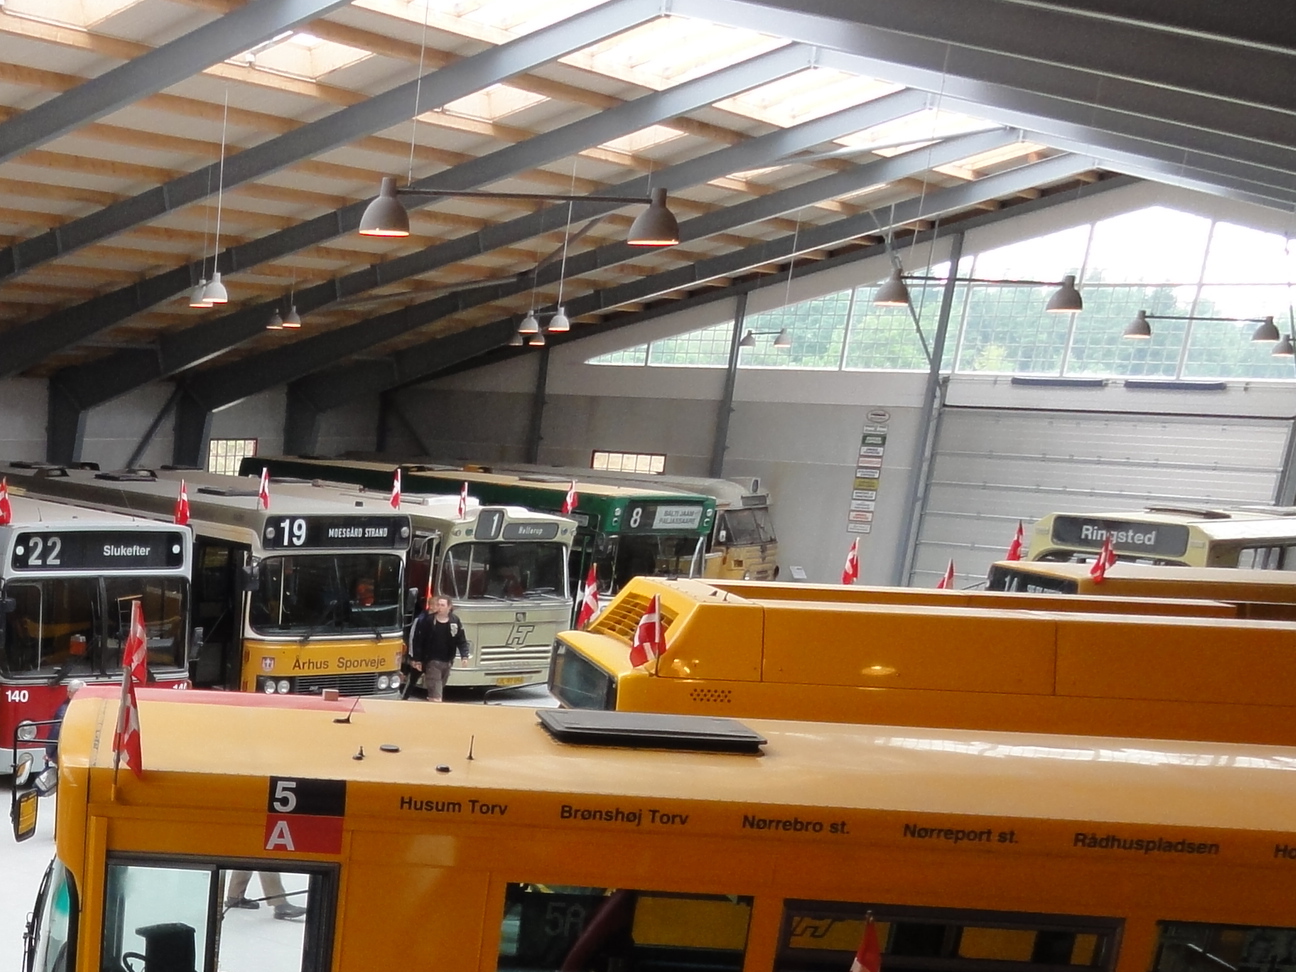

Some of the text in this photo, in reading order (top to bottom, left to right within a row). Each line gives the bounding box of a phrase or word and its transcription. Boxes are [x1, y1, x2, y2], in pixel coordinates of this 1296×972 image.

[490, 513, 499, 537] 1
[630, 507, 642, 528] 8
[280, 518, 307, 546] 19
[328, 526, 388, 538] MOESGÅRD STRAND
[27, 536, 62, 566] 22
[103, 545, 151, 556] Slukefter
[292, 656, 386, 671] Århus Sporveje
[6, 690, 29, 702] 140
[273, 780, 297, 813] 5
[400, 796, 508, 816] Husum Torv
[560, 804, 689, 827] Brønshøj Torv
[742, 814, 850, 835] Nørrebro st.
[265, 820, 295, 851] A
[903, 823, 1019, 845] Nørreport st.
[1073, 831, 1220, 856] Rådhuspladsen
